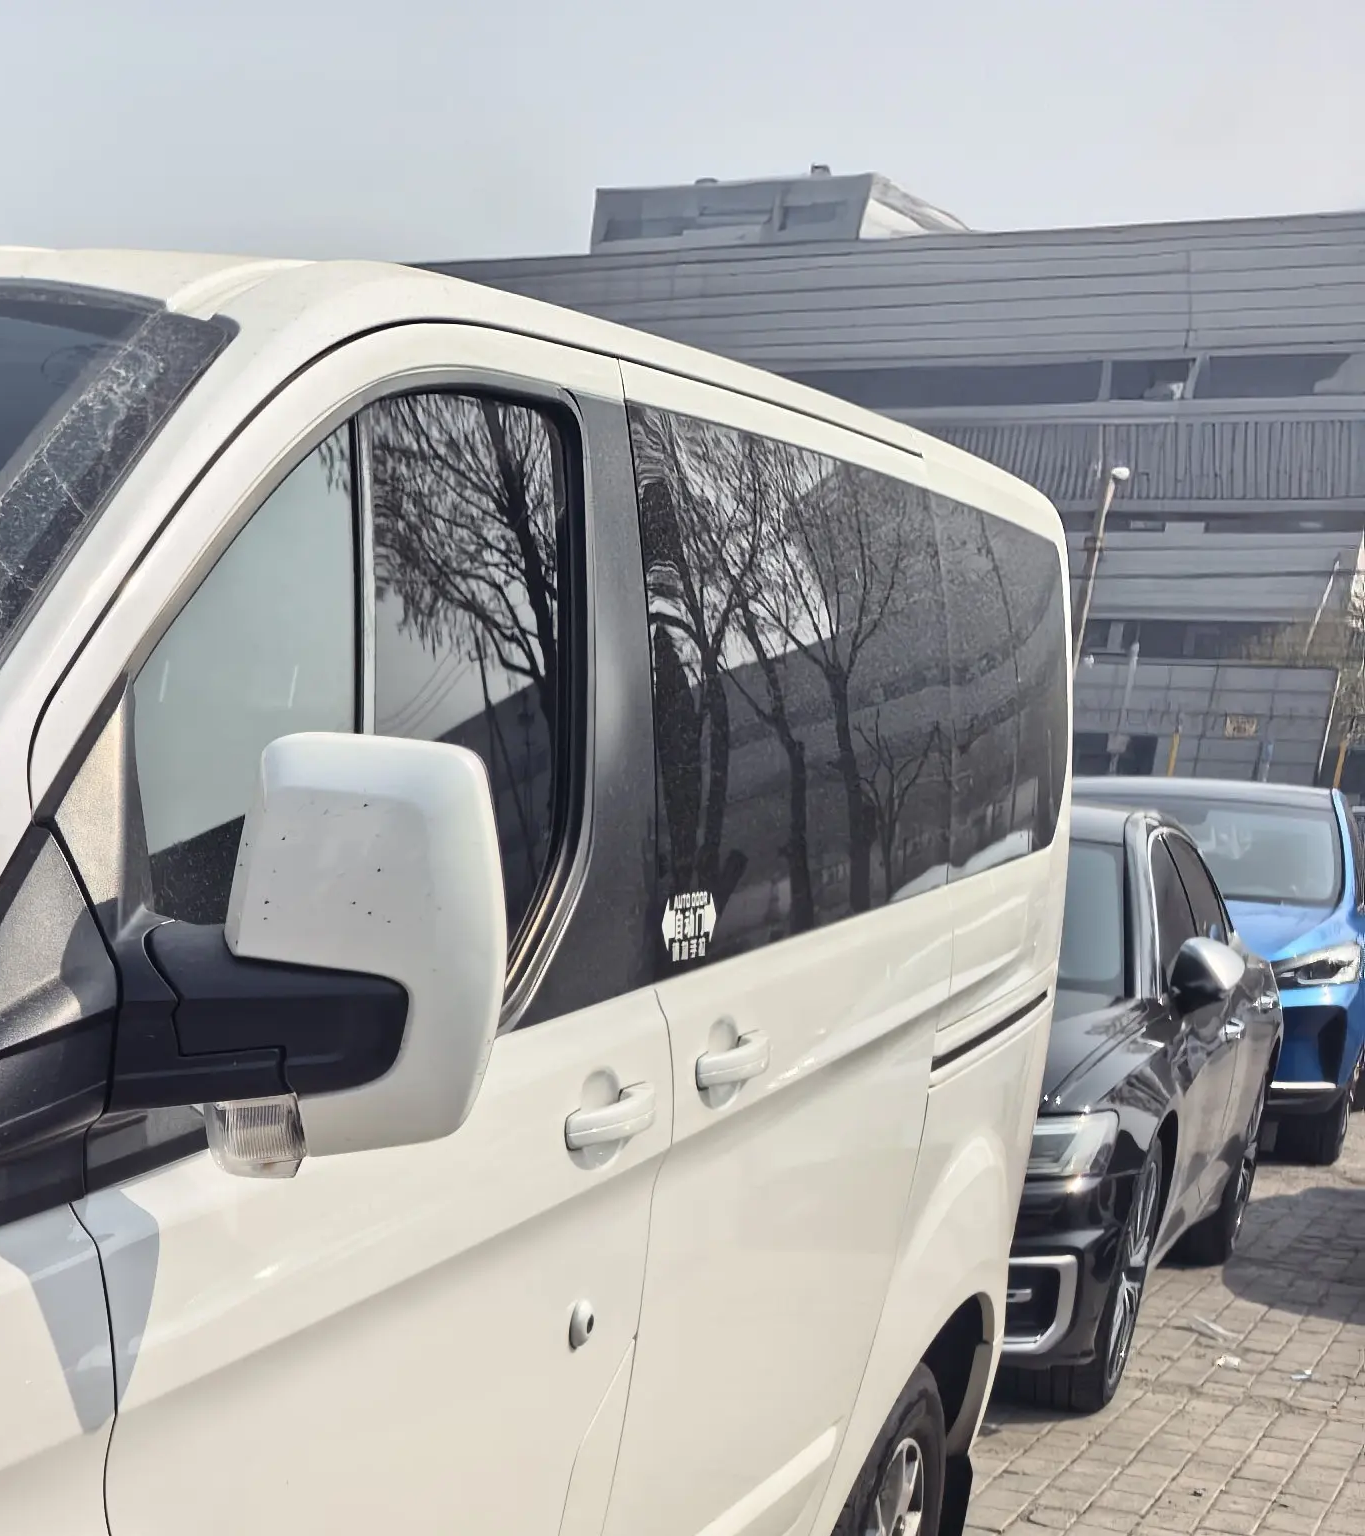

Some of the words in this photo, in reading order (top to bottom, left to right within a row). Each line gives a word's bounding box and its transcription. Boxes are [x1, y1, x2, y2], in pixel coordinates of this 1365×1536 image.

[673, 893, 691, 909] AUTO
[691, 890, 708, 906] DOOR
[674, 907, 705, 941] 自动门
